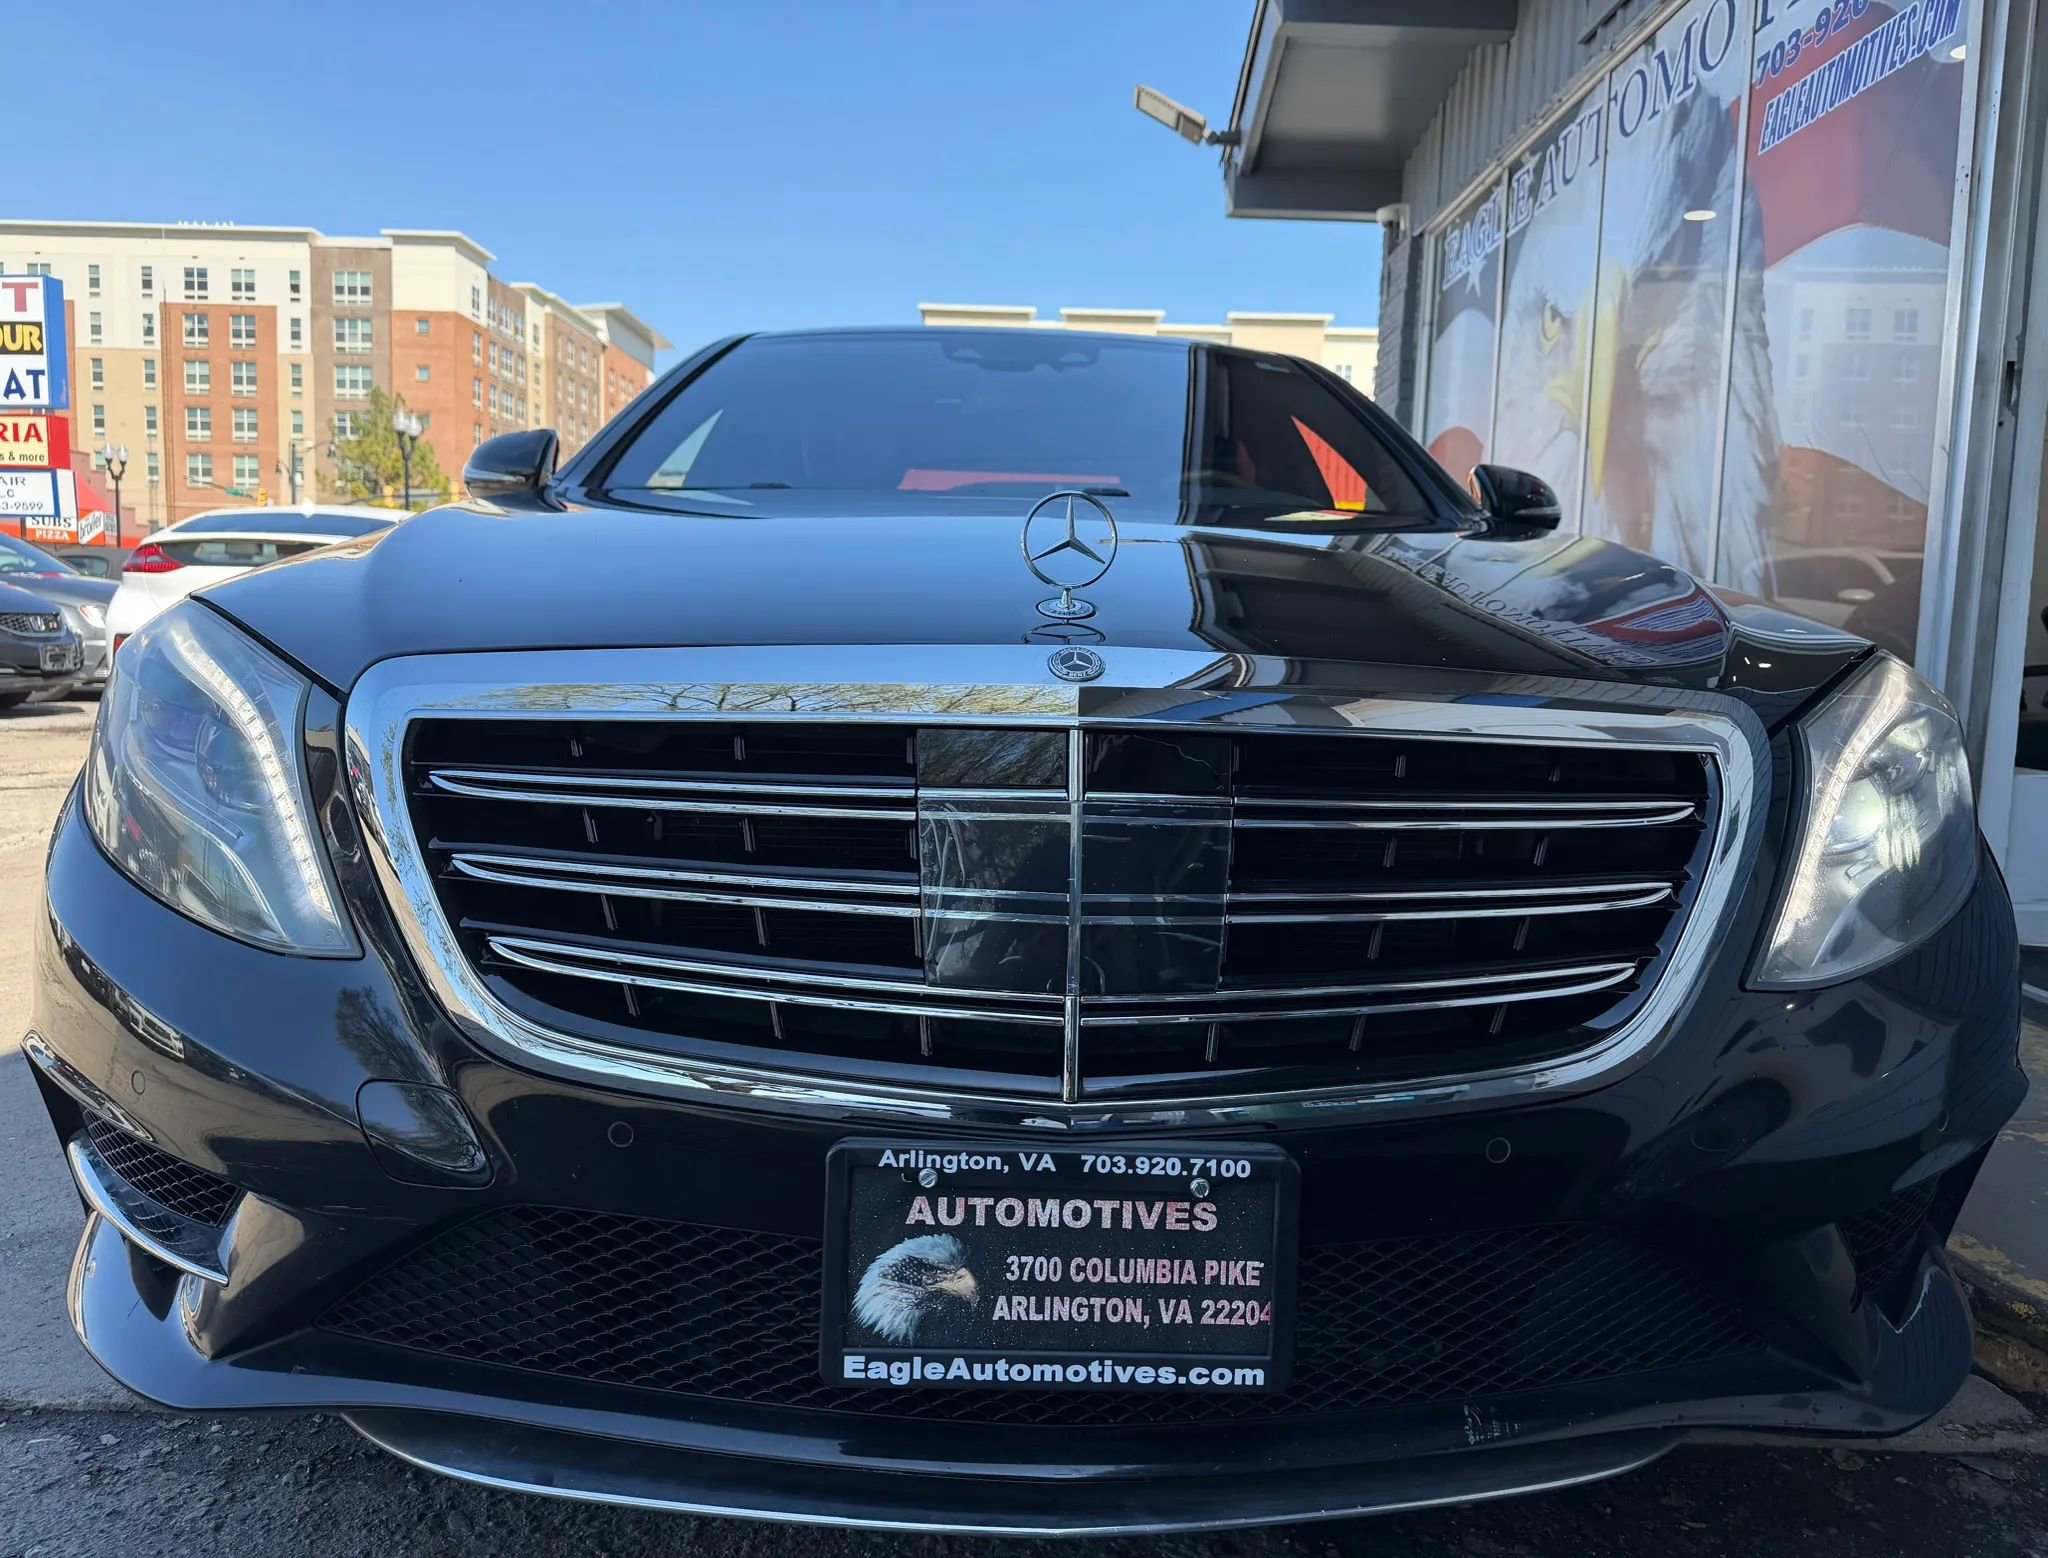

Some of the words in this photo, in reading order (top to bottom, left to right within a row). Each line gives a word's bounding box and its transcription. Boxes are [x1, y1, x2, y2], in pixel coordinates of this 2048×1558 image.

[2, 282, 38, 312] T
[0, 323, 42, 351] UR
[19, 453, 45, 462] more
[35, 529, 70, 541] PIZZA
[878, 1149, 1010, 1174] Arlington,
[1018, 1152, 1057, 1172] VA
[1080, 1154, 1252, 1178] 703.920.7100
[905, 1196, 1219, 1232] AUTOMOTIVES
[1005, 1255, 1063, 1283] 3700
[1069, 1257, 1198, 1285] COLUMBIA
[1204, 1259, 1264, 1287] PIKE
[992, 1295, 1150, 1329] ARLINGTON,
[1158, 1299, 1194, 1324] VA
[843, 1355, 1266, 1387] EagleAutomotives.com
